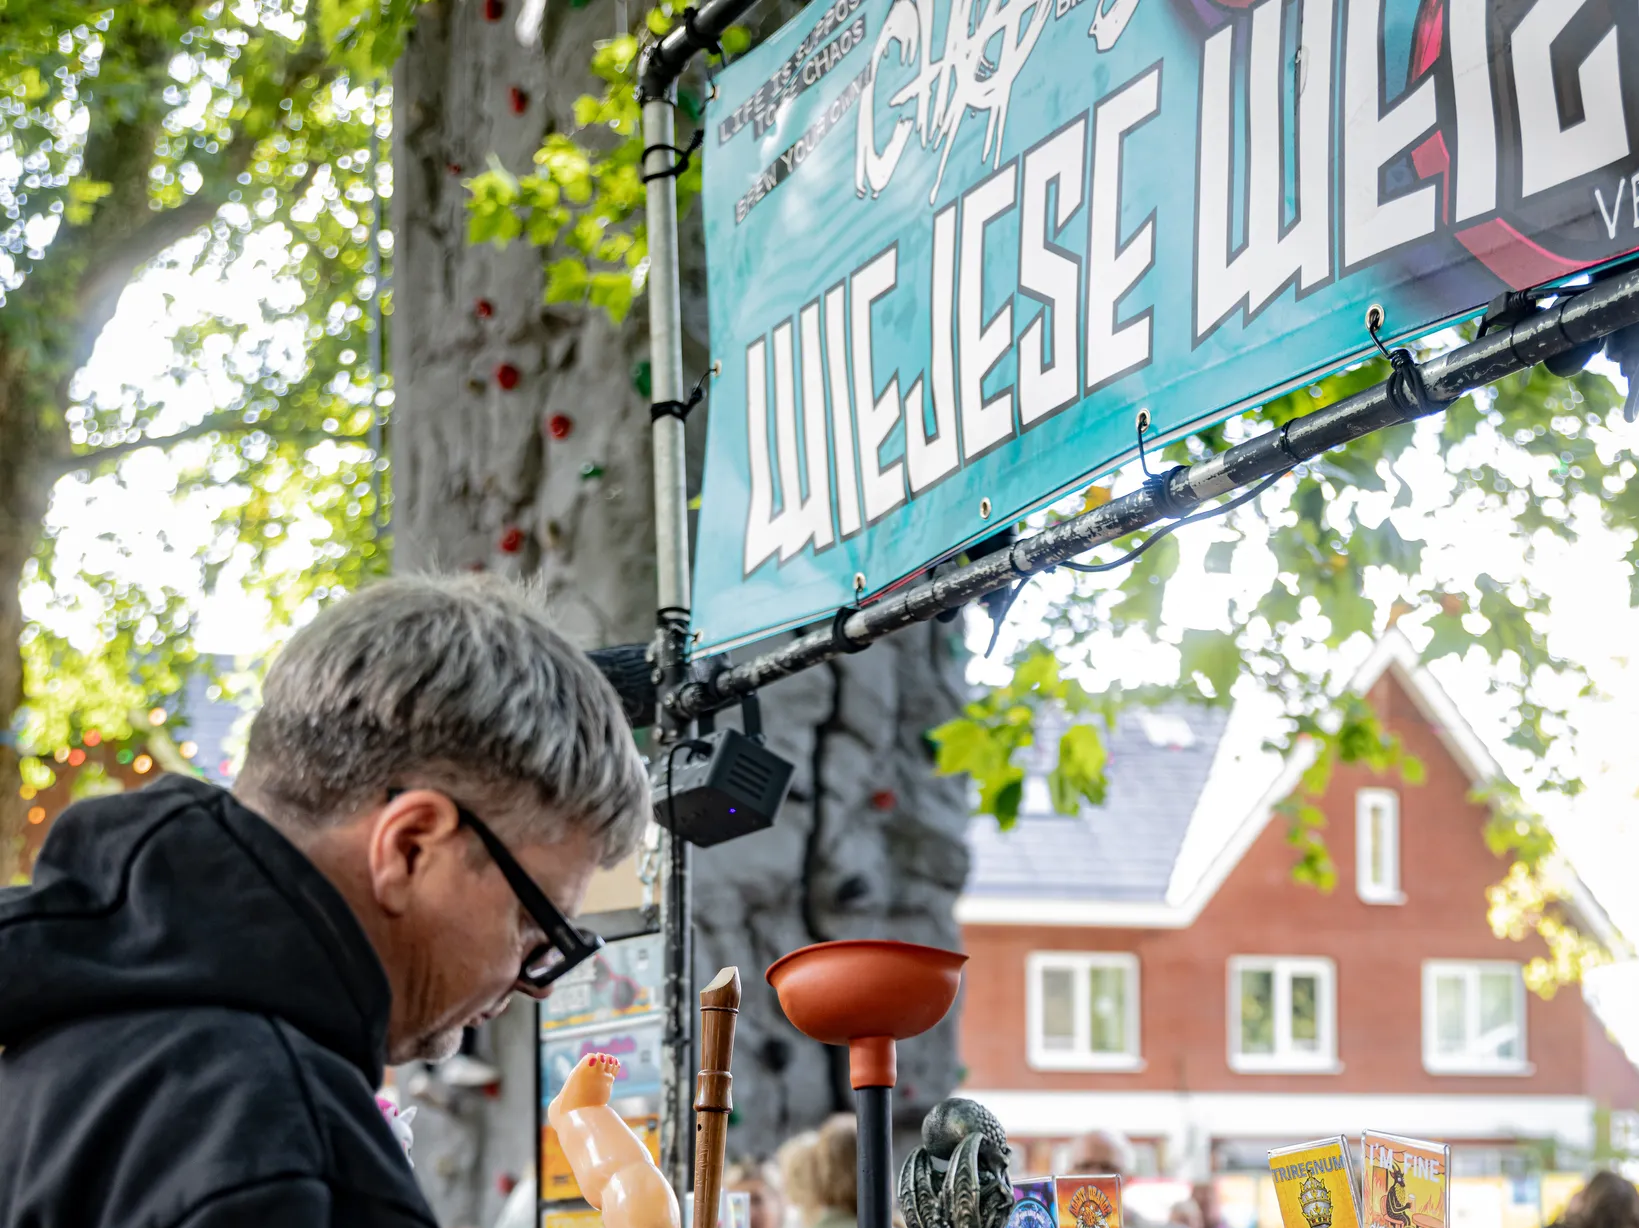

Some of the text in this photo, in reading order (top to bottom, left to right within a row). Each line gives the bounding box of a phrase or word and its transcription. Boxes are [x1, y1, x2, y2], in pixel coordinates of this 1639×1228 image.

[802, 19, 866, 86] CHAOS
[719, 92, 765, 144] LIFE
[771, 61, 793, 92] IS
[780, 117, 828, 174] YOUR
[744, 66, 1161, 579] WIEJESE
[1272, 1155, 1346, 1183] TRIREGNUM
[1369, 1143, 1440, 1183] I'M FINE
